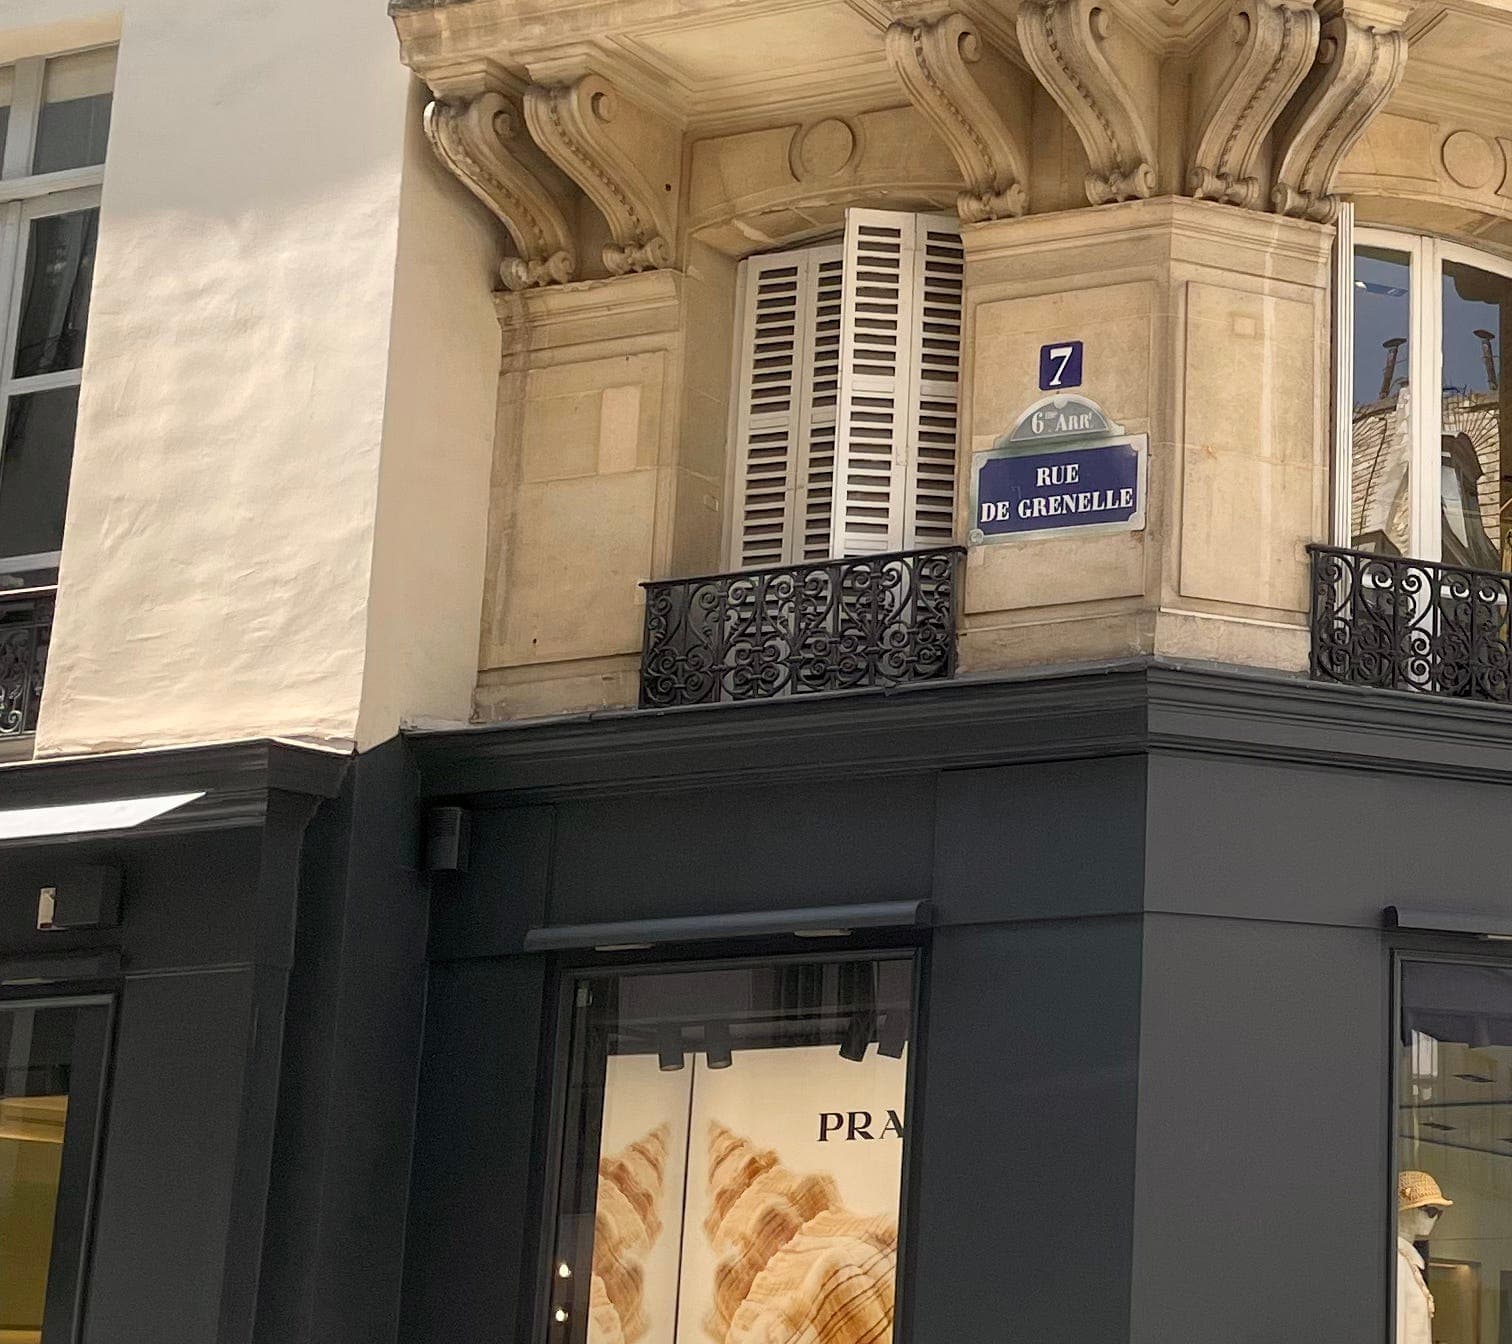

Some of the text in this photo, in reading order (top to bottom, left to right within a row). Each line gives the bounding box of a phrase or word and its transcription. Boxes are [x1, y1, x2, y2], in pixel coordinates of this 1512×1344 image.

[1049, 346, 1073, 387] 7
[1036, 463, 1080, 487] RUE
[980, 487, 1134, 523] DE GRENELLE
[816, 1109, 904, 1142] PRA
